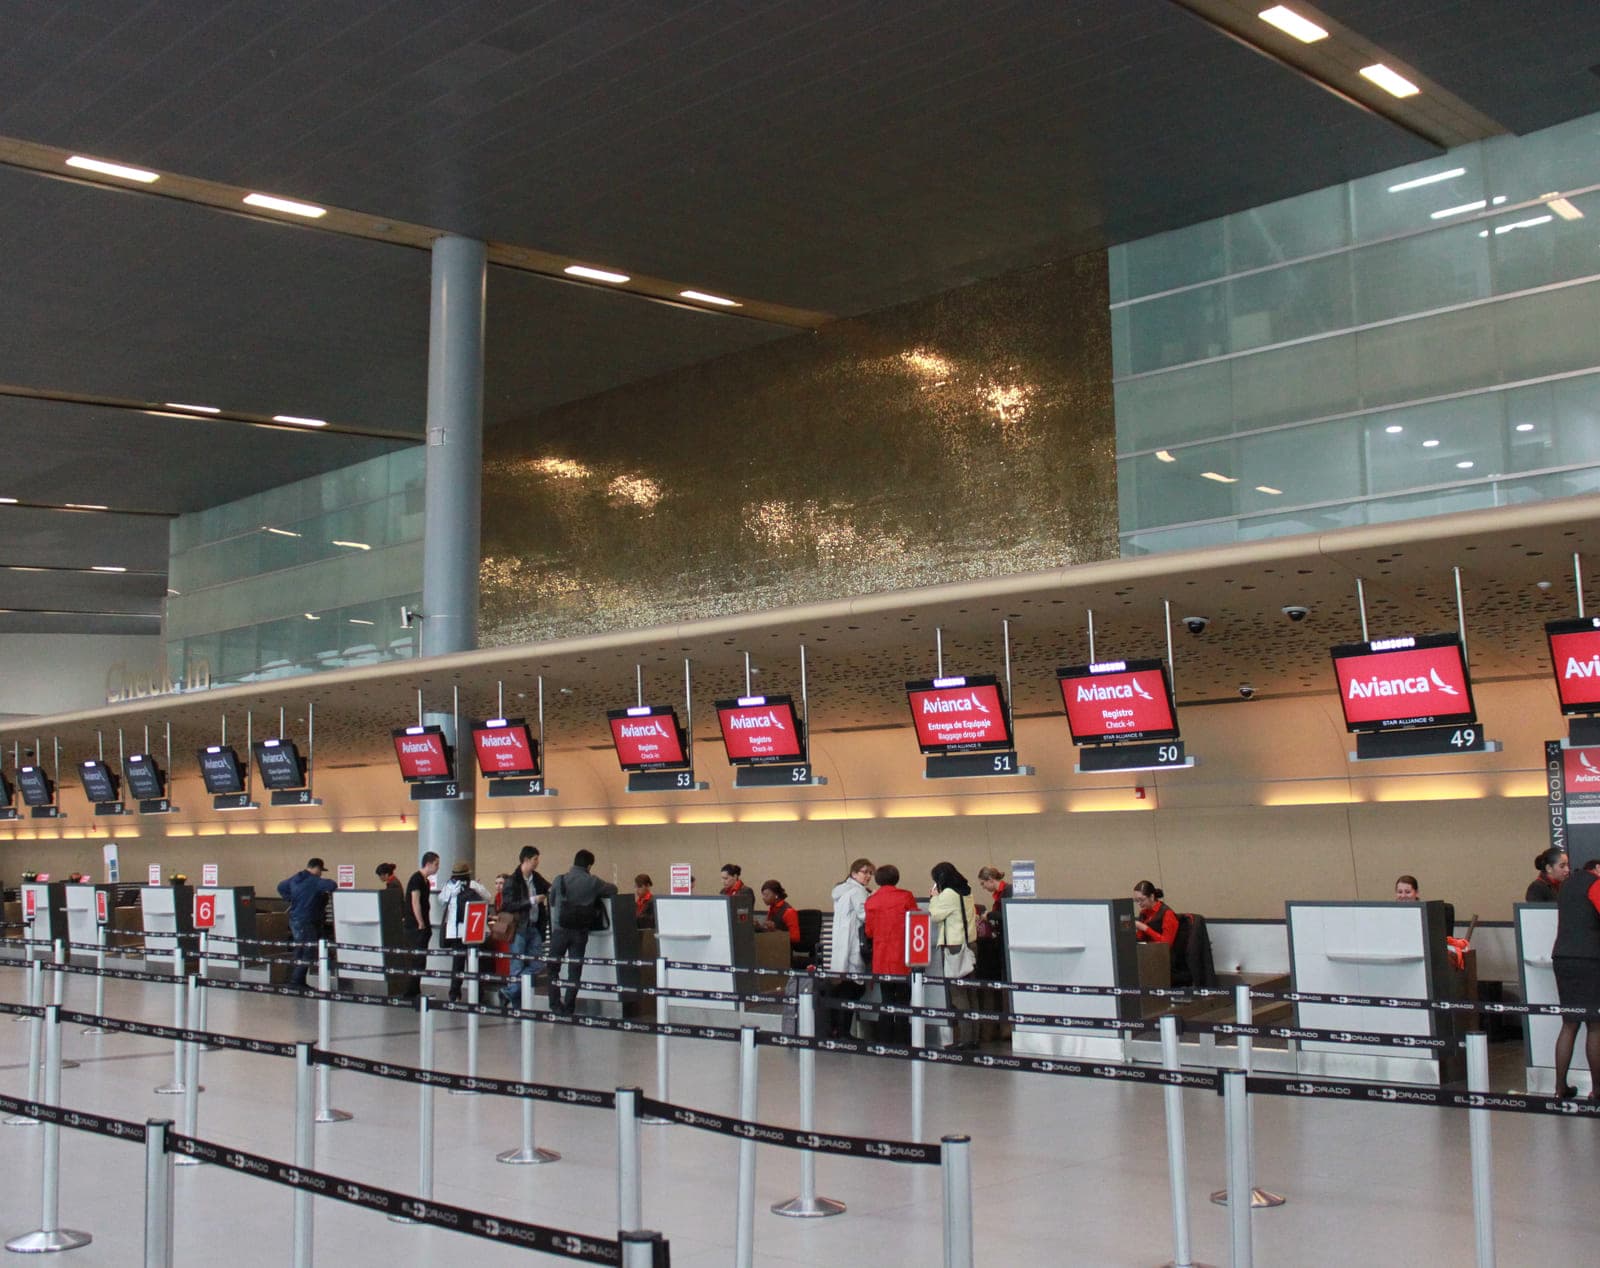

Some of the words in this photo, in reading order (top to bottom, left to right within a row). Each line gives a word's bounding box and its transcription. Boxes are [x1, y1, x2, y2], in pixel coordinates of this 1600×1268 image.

[1077, 684, 1133, 702] Avianca
[1348, 676, 1430, 699] Avianca
[923, 697, 972, 714] Avianca
[1102, 709, 1133, 719] Registro
[730, 714, 770, 729] Avianca
[928, 722, 953, 731] Entrega
[963, 719, 991, 729] Equipaje
[621, 722, 657, 737] Avianca
[481, 734, 512, 748] Avianca
[749, 735, 772, 744] Registro
[1450, 729, 1475, 748] 49
[402, 741, 429, 753] Avianca
[1158, 745, 1178, 761] 50
[993, 756, 1011, 770] 51
[677, 773, 690, 786] 53
[791, 767, 807, 781] 52
[1549, 761, 1561, 801] GOLD
[446, 784, 456, 796] 55
[529, 780, 540, 793] 54
[1552, 807, 1565, 852] ANCE
[200, 902, 211, 920] 6
[471, 911, 482, 927] 7
[913, 924, 925, 952] 8
[1300, 1083, 1350, 1094] DORADO
[1382, 1088, 1435, 1100] DORADO
[1470, 1094, 1525, 1107] DORADO
[878, 1143, 924, 1157] DORADO
[486, 1219, 534, 1241] DORADO
